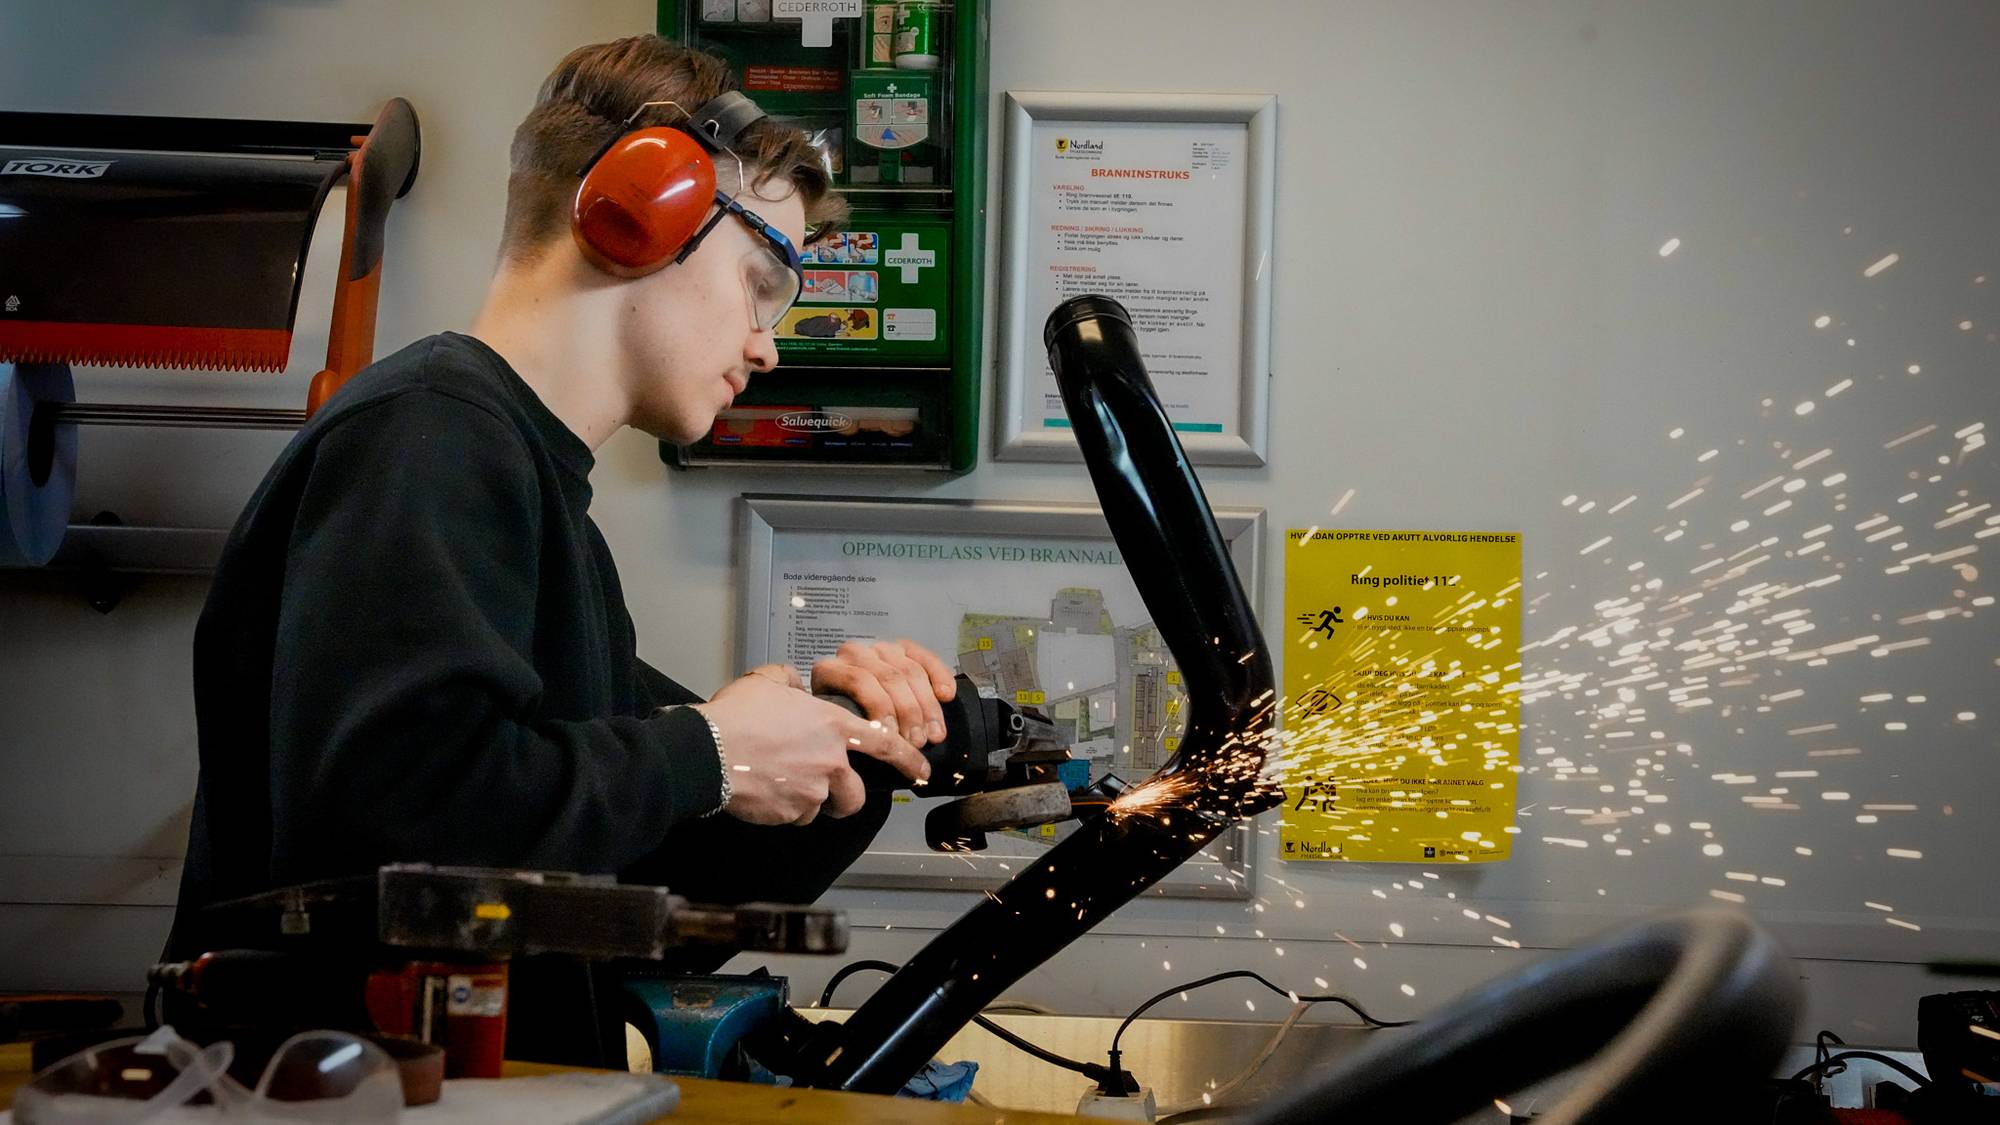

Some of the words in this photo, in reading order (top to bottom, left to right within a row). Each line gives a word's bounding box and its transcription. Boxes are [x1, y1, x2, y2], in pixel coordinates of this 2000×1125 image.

[778, 2, 856, 13] CEDERROTH
[1069, 140, 1104, 150] Nordland
[9, 162, 103, 175] TORK
[1090, 168, 1191, 180] BRANNINSTRUKS
[887, 257, 933, 265] CEDERROTH
[781, 415, 847, 429] Salvequick
[1290, 532, 1334, 540] HVDAN
[1336, 532, 1371, 541] OPPTRE
[1372, 533, 1391, 541] VED
[1392, 533, 1421, 542] AKUTT
[1423, 534, 1468, 542] ALVORLIG
[1470, 535, 1516, 543] HENDELSE
[842, 541, 983, 562] OPPMØTEPLASS
[987, 546, 1025, 563] VED
[1030, 547, 1124, 566] BRANNAL
[783, 572, 802, 581] Bodø
[803, 573, 856, 583] videregående
[858, 574, 877, 583] skole
[1351, 574, 1380, 587] Ring
[1383, 574, 1429, 588] politiet
[1301, 841, 1343, 853] Nordlad
